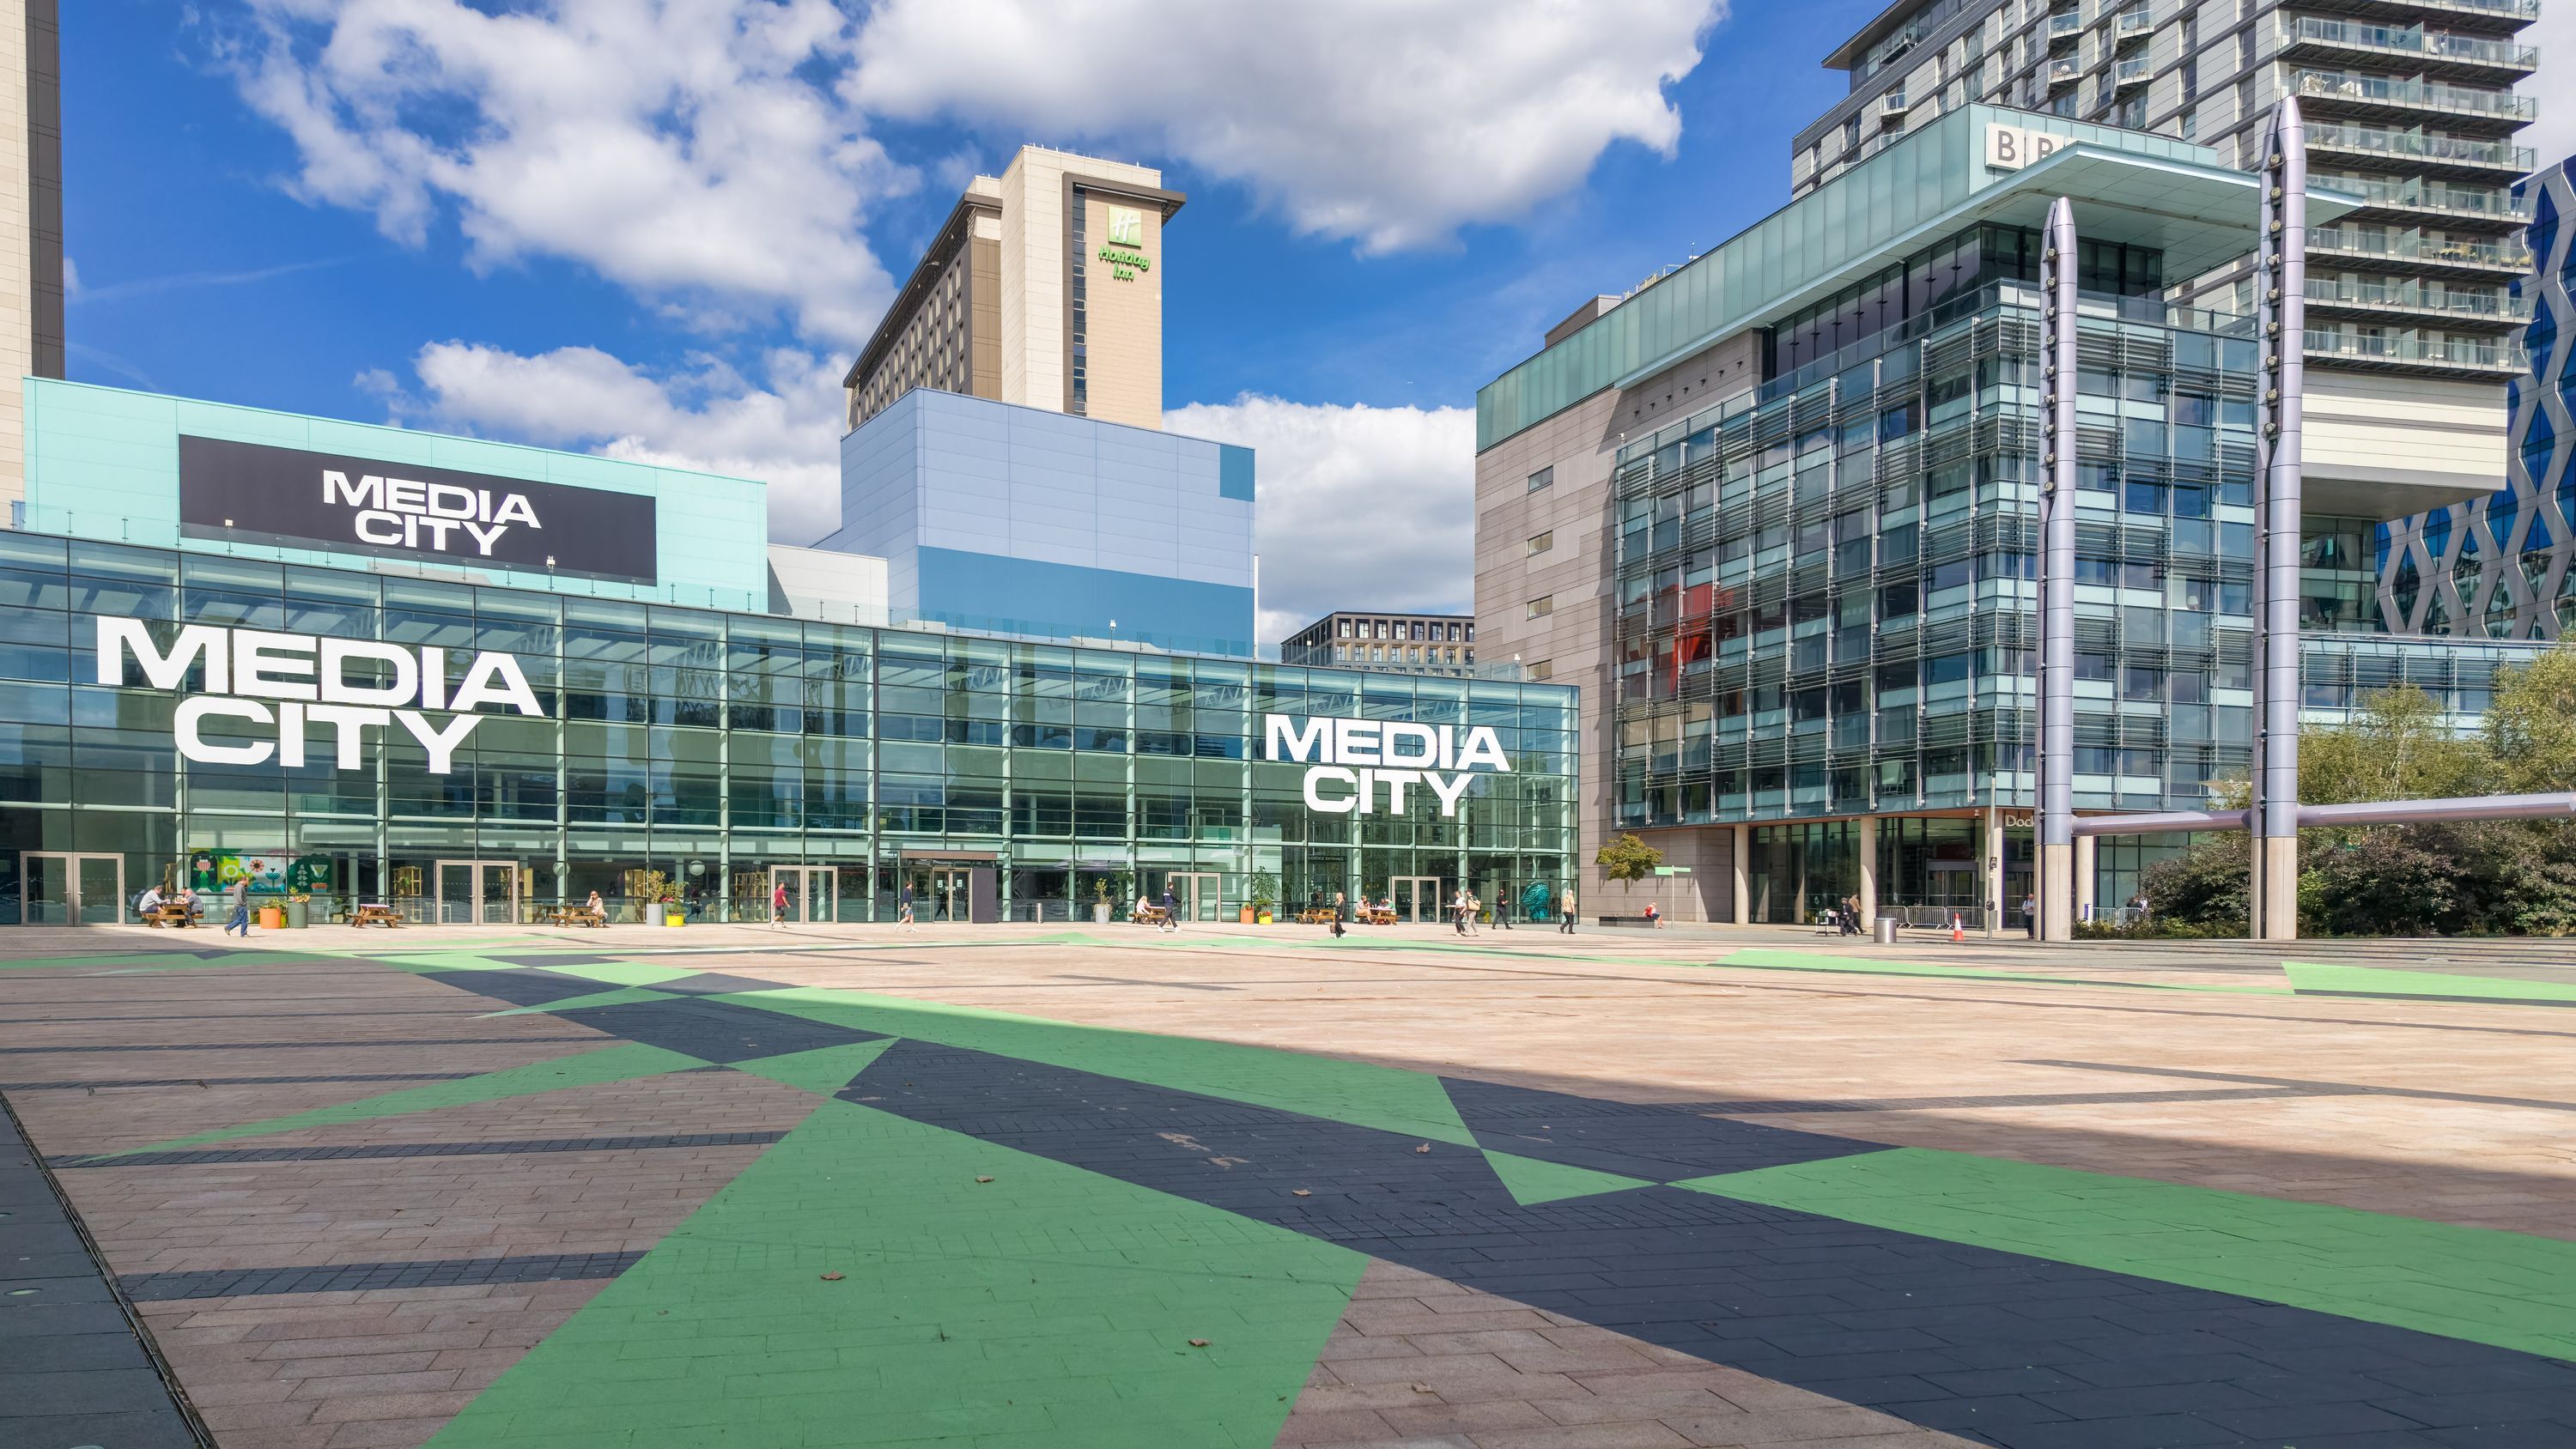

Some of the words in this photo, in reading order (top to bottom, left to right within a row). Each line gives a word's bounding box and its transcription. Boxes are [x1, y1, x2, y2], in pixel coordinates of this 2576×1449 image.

[1099, 246, 1150, 270] Holiday
[1113, 262, 1134, 281] Inn
[323, 470, 542, 529] MEDIA
[355, 509, 508, 556] CITY
[96, 615, 544, 717] MEDIA
[173, 696, 485, 774] CITY
[1265, 713, 1511, 772] MEDIA
[1303, 766, 1475, 817] CITY
